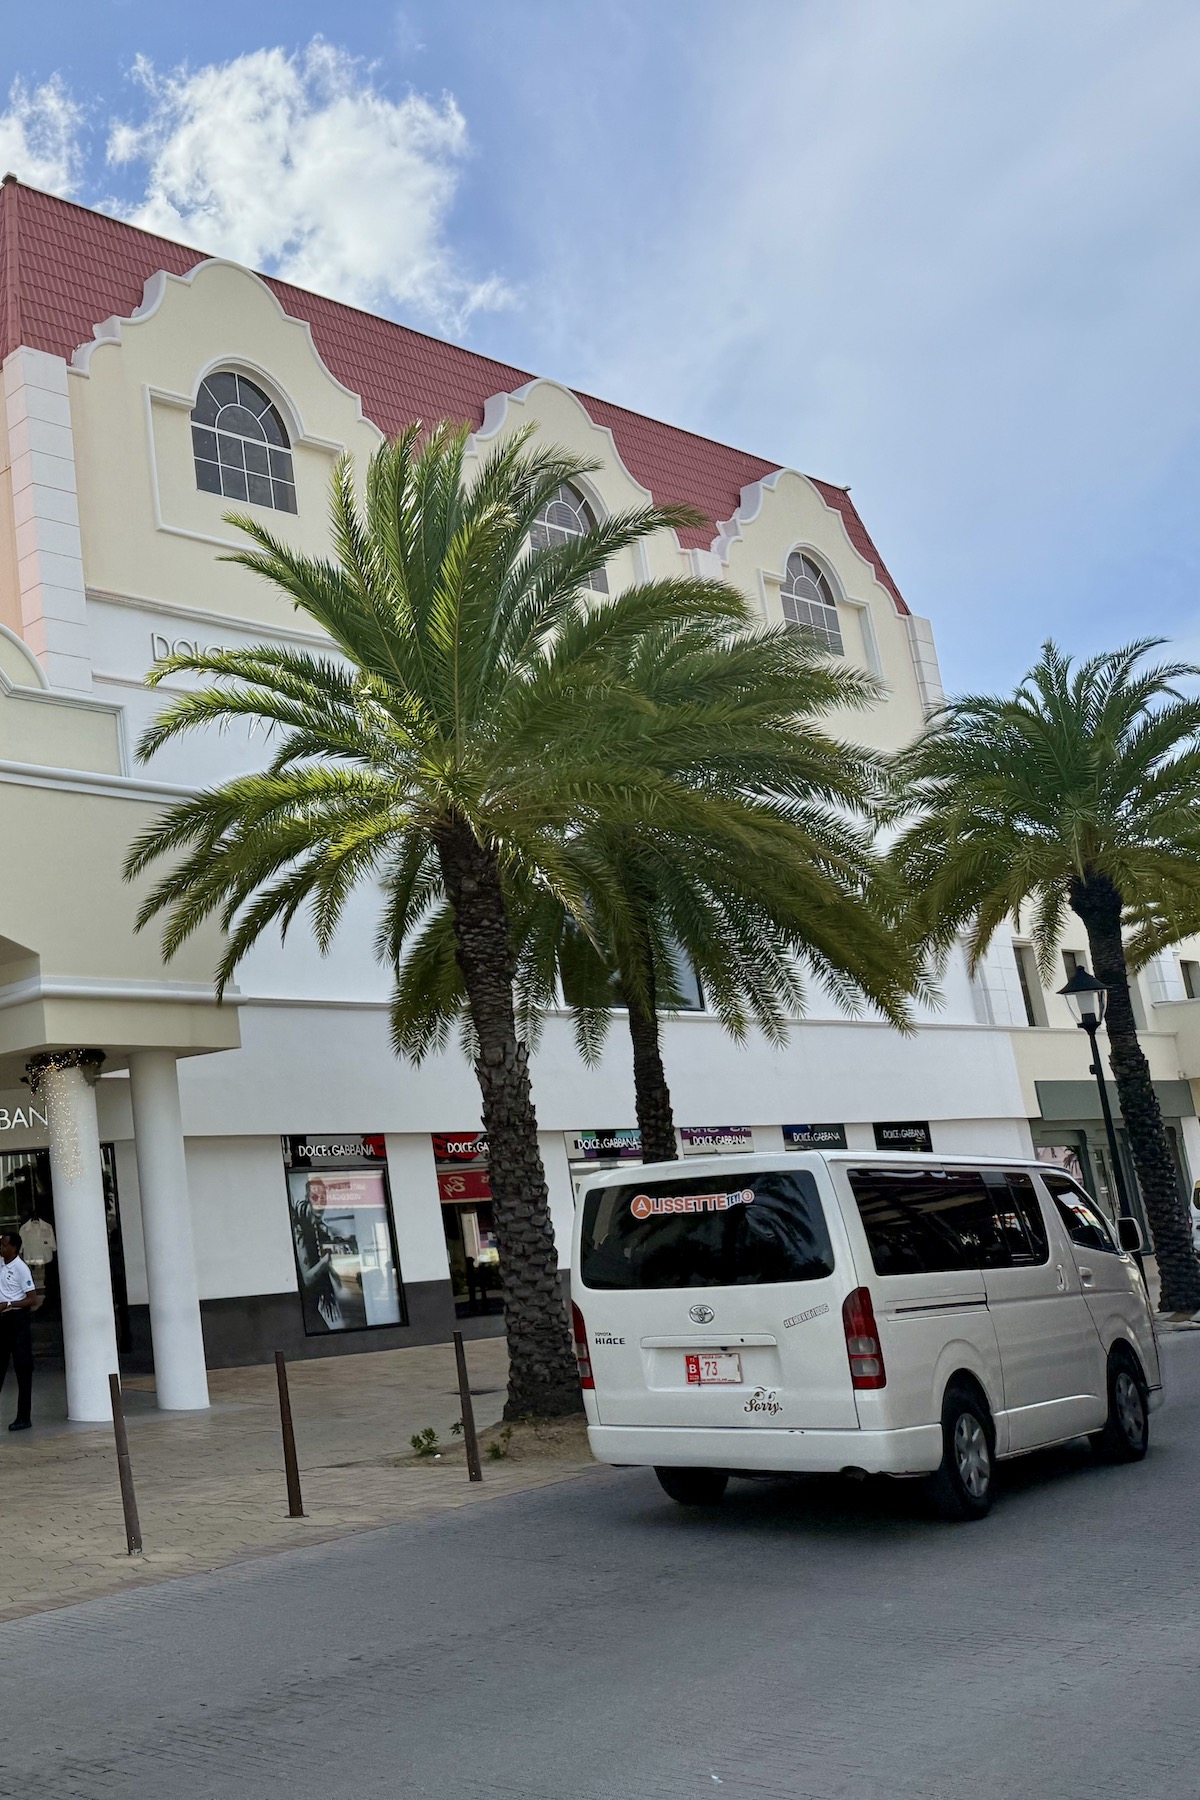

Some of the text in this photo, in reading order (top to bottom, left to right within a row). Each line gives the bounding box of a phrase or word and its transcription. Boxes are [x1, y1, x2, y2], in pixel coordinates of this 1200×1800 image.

[298, 1144, 326, 1157] DOLCE
[331, 1144, 375, 1157] GABBANA
[595, 1337, 625, 1345] HIACE
[689, 1361, 718, 1376] B 73
